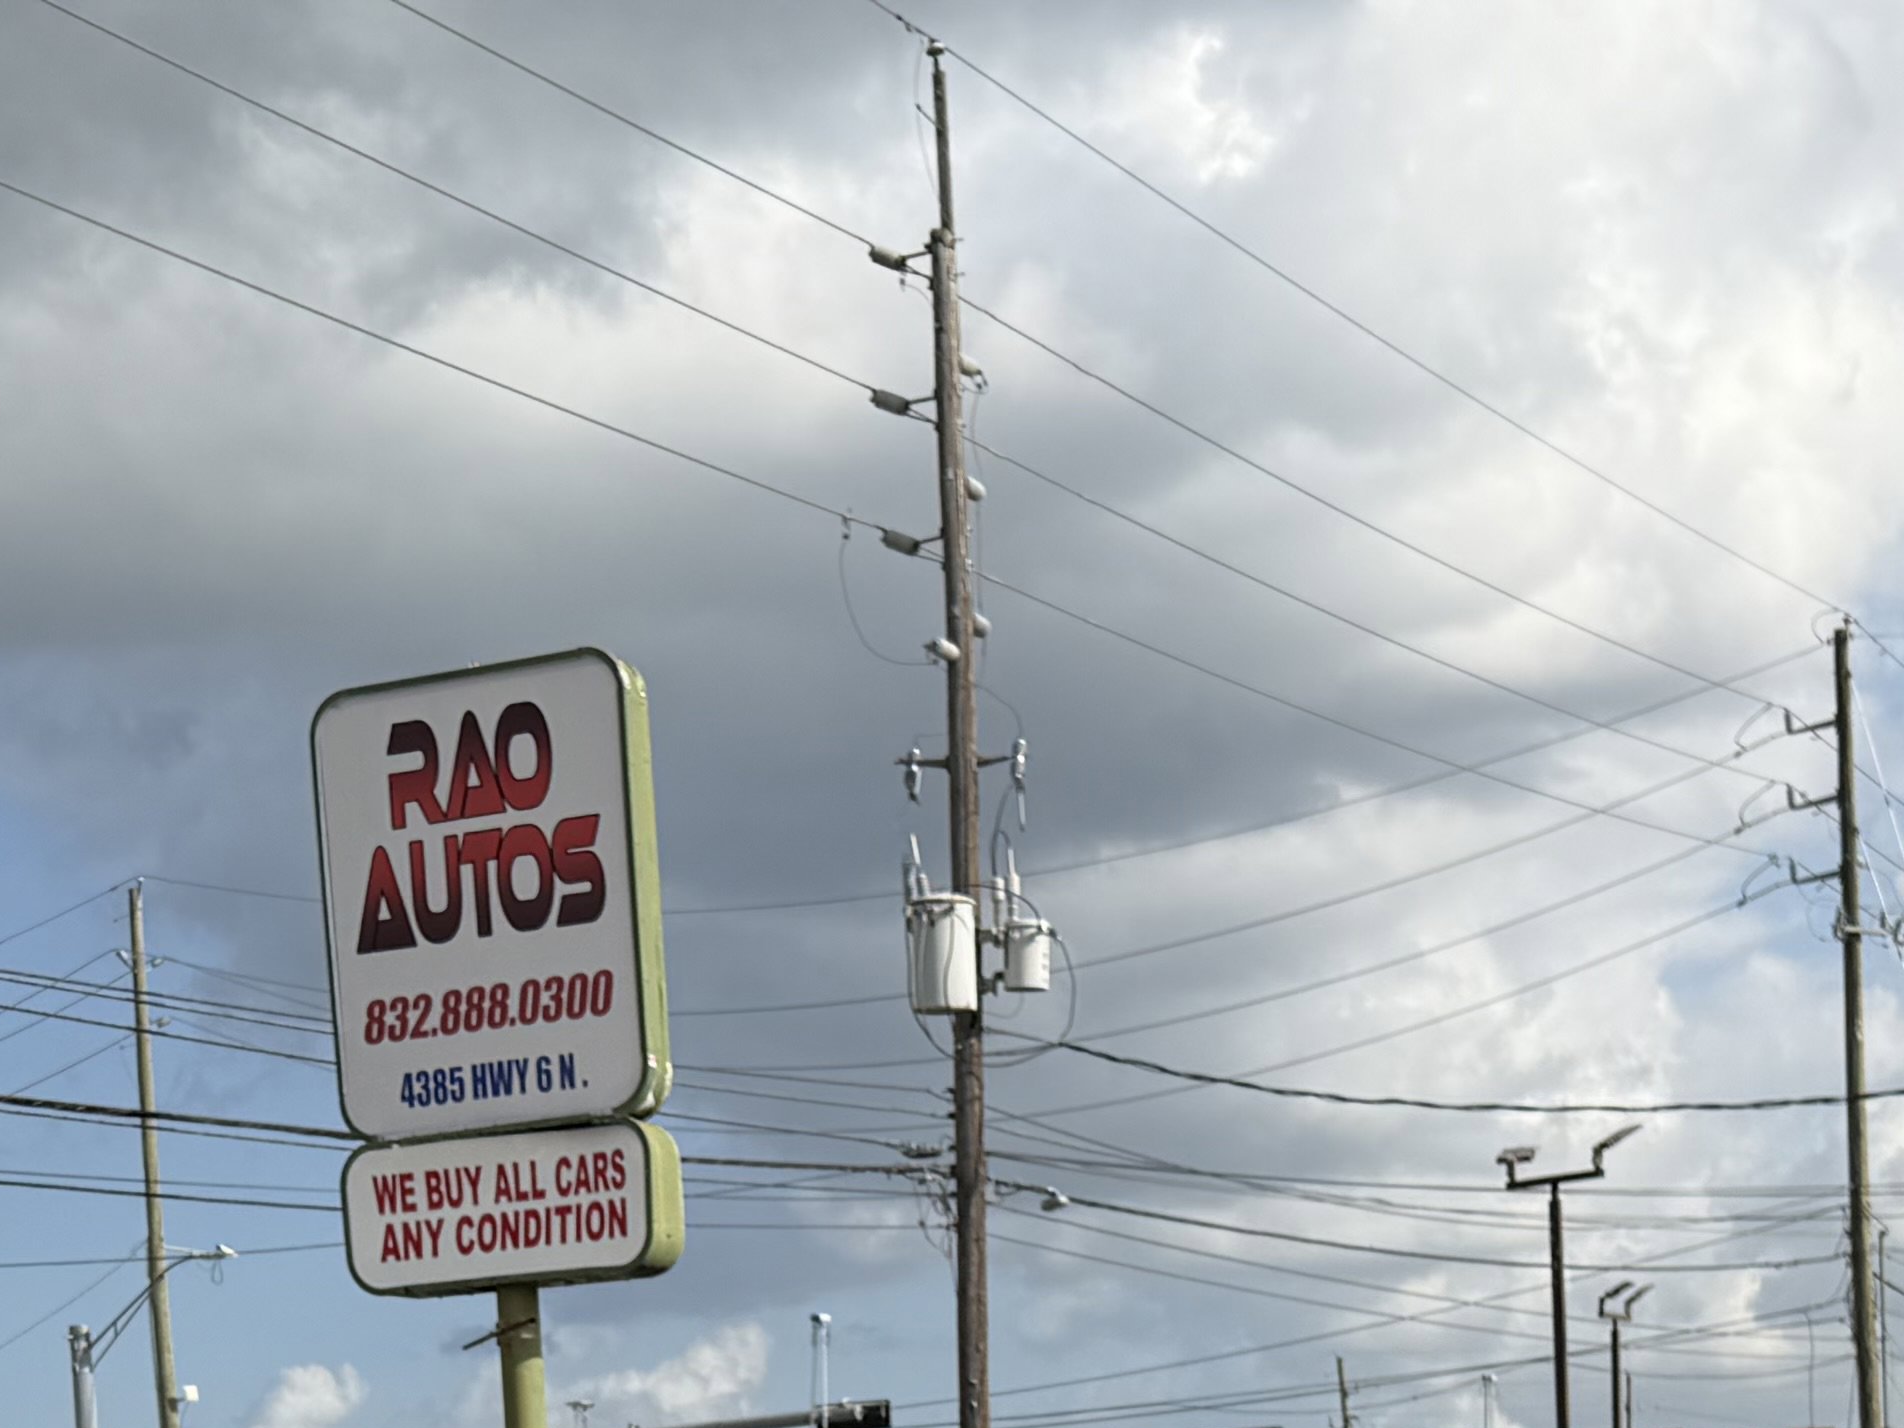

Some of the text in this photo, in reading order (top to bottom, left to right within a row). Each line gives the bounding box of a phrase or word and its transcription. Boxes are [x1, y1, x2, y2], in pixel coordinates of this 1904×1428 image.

[387, 701, 552, 830] RAO
[356, 813, 606, 955] AUTOS
[364, 969, 614, 1046] 832.888.0300
[400, 1066, 465, 1109] 4385
[471, 1057, 529, 1101] HWY
[536, 1055, 553, 1093] 6
[372, 1148, 627, 1216] WE BUY ALL CARS
[381, 1197, 629, 1264] ANY CONDITION
